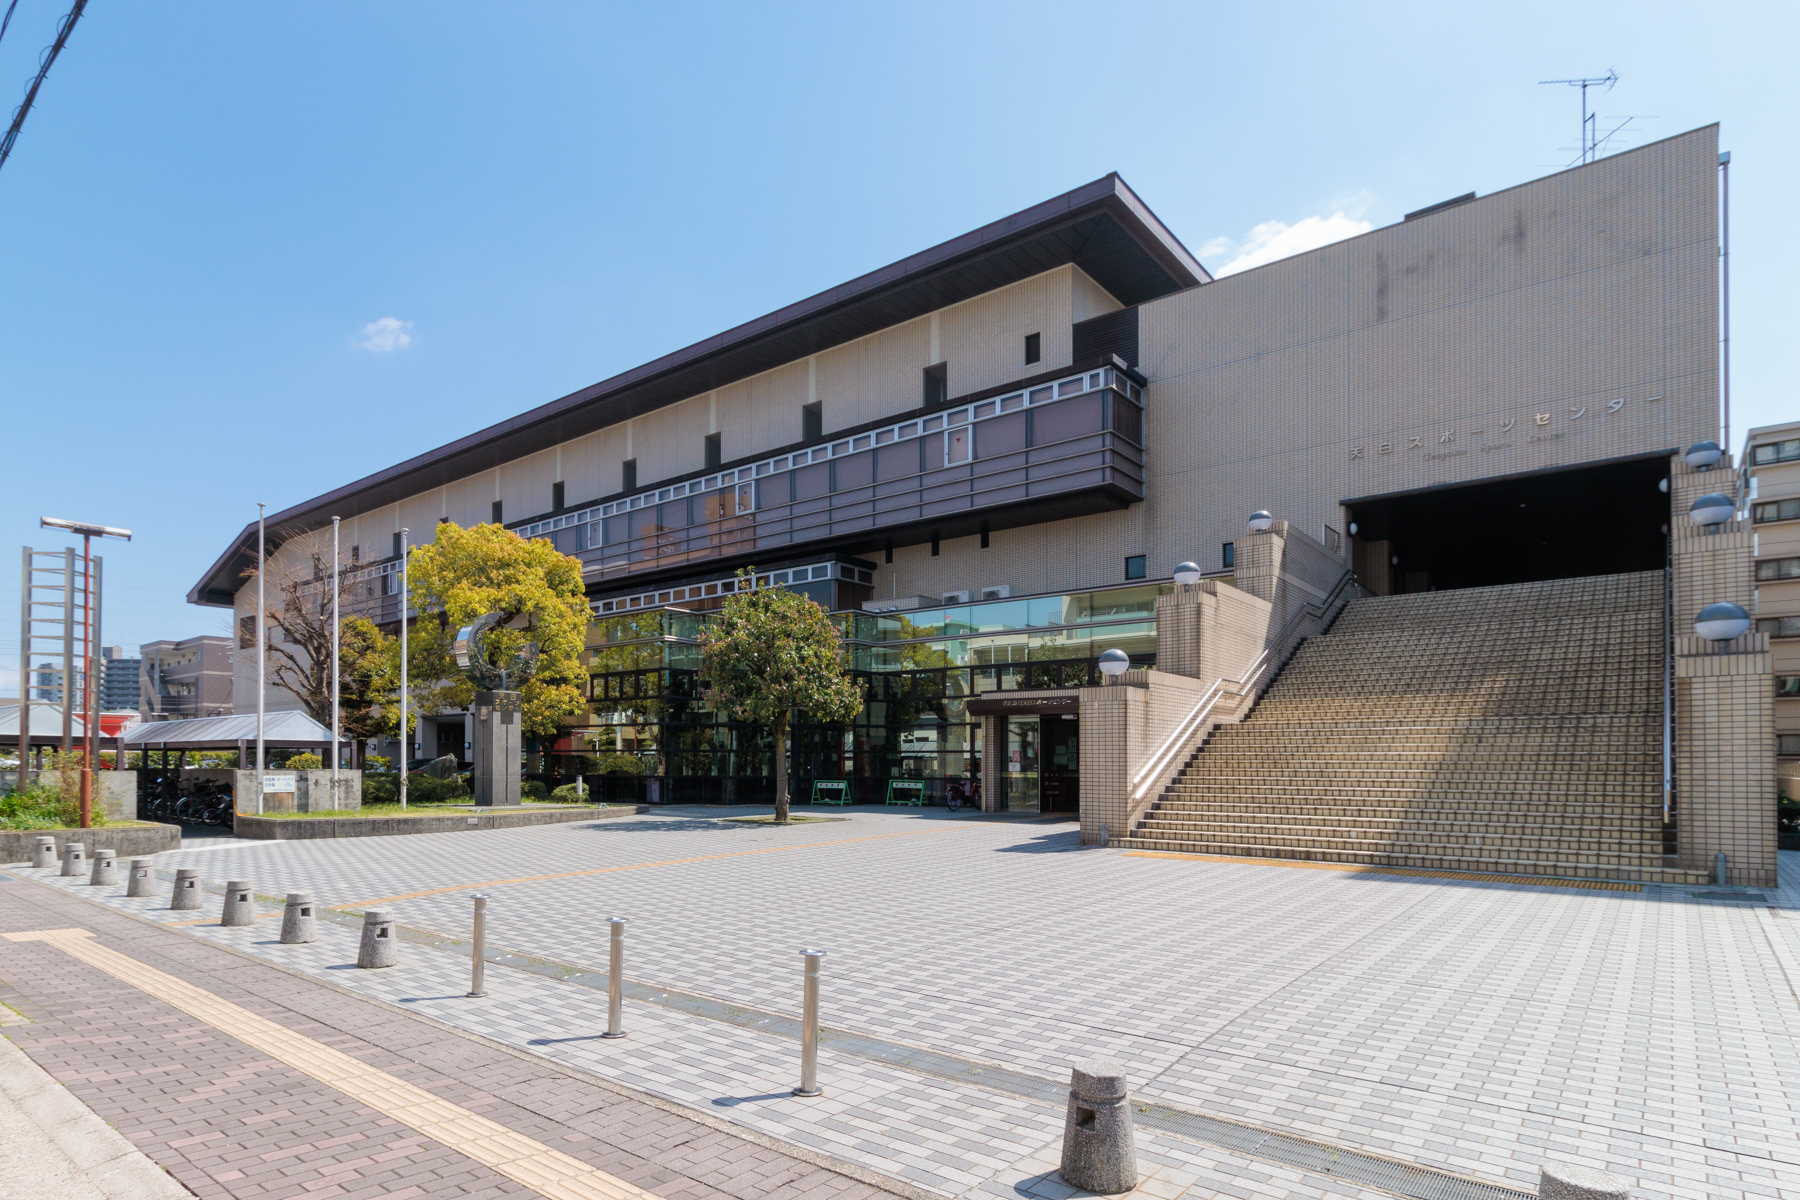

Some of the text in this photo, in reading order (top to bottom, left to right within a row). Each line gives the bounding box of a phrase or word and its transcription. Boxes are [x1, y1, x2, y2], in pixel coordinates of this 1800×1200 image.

[1349, 395, 1663, 460] 天白スポーツセンター
[498, 692, 517, 700] 天白
